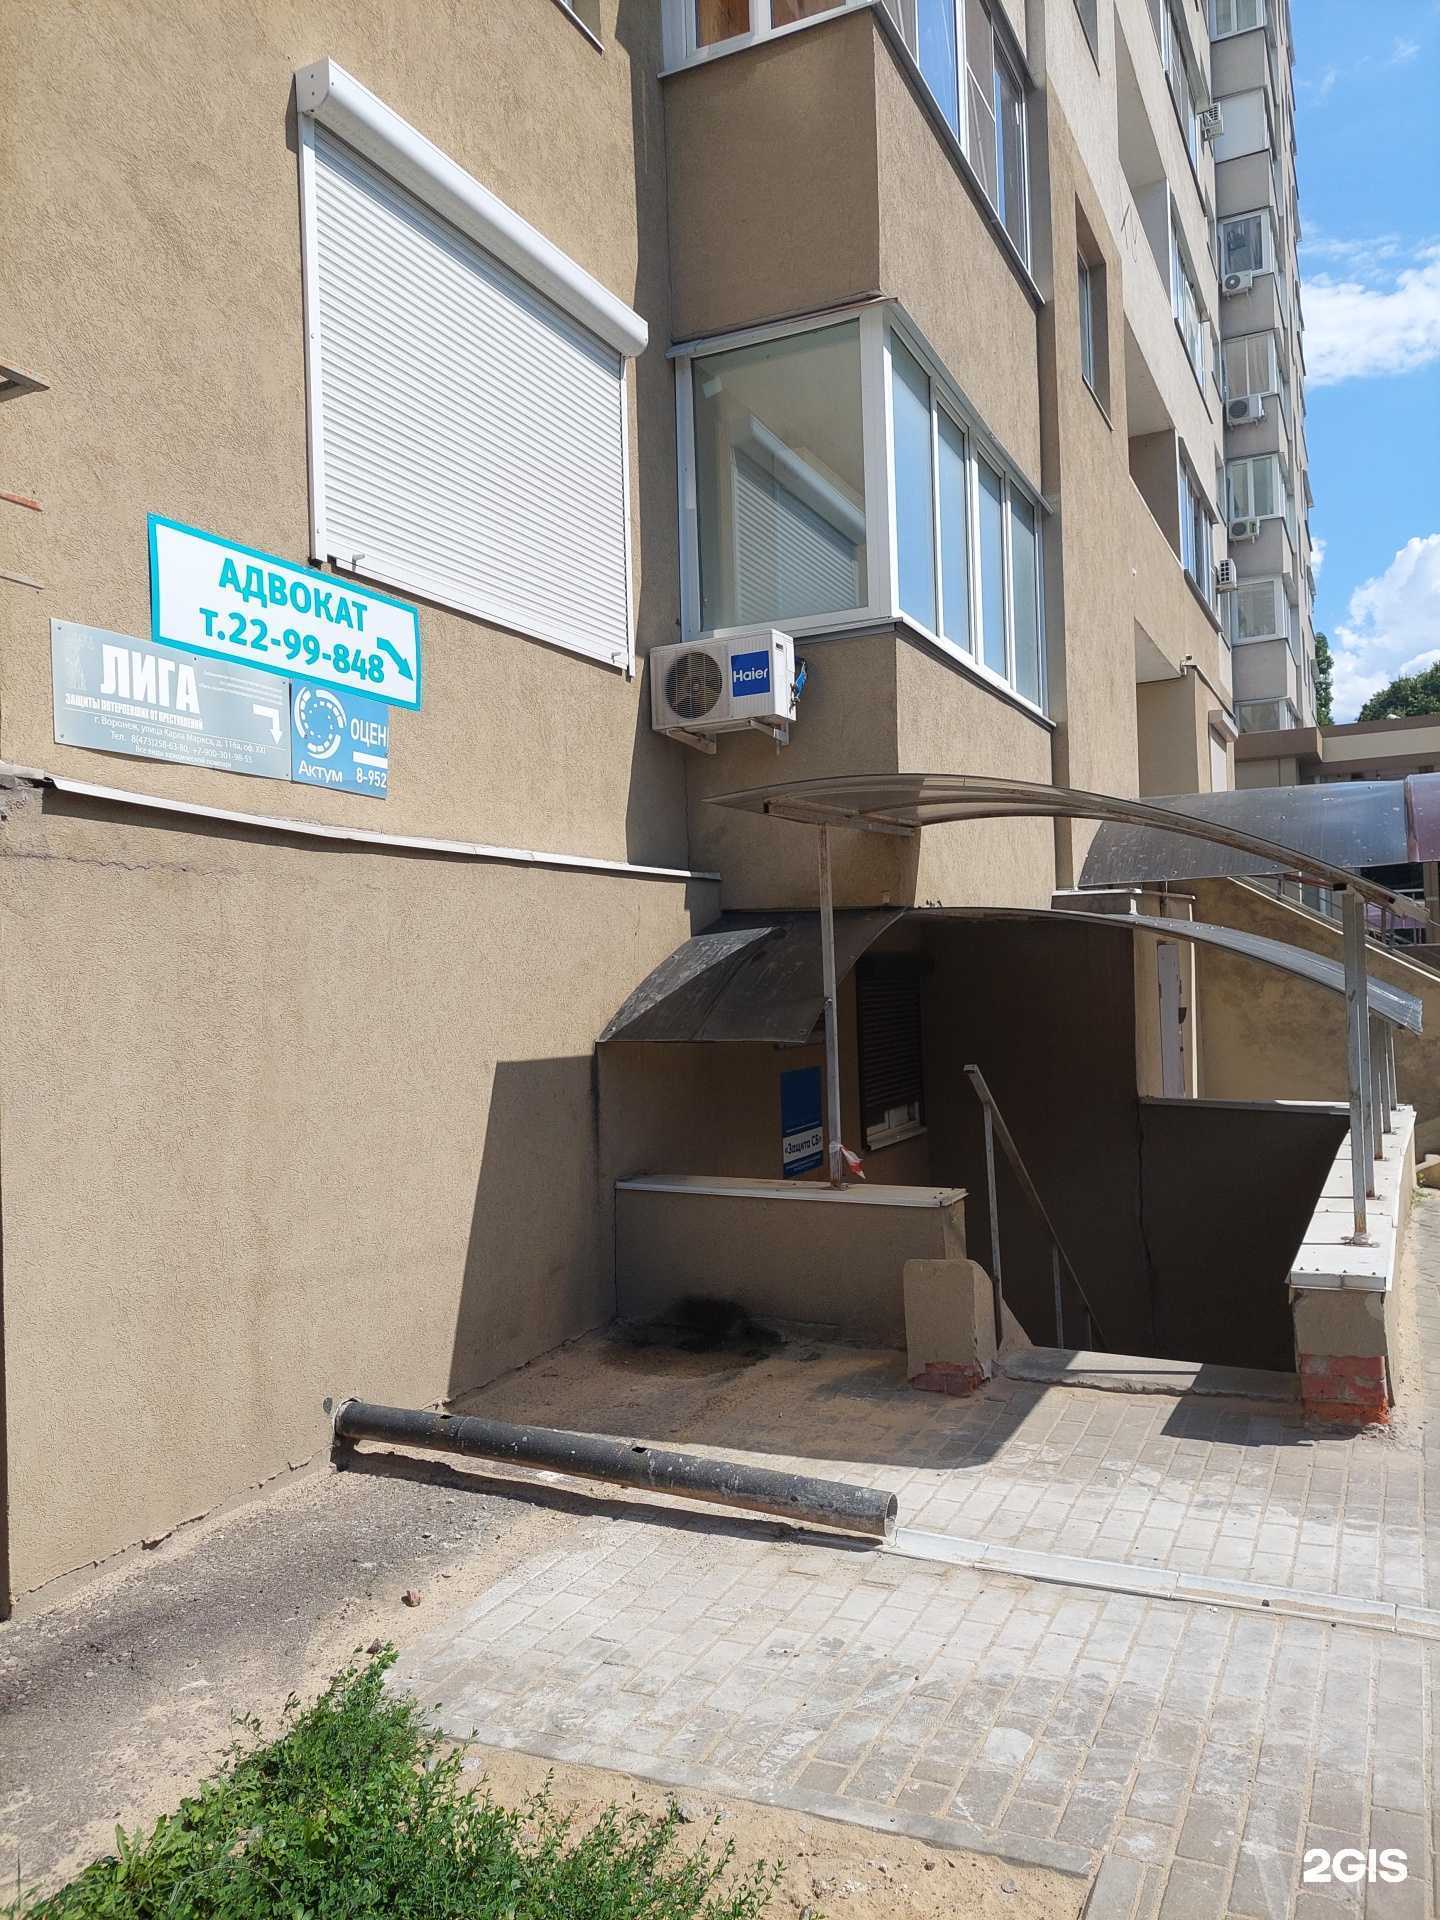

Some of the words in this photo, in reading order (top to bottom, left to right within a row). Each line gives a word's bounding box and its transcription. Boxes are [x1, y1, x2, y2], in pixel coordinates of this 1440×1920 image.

[219, 558, 368, 632] АДВОКАТ
[100, 643, 201, 714] ЛИГА
[733, 667, 768, 683] Haier
[65, 692, 100, 710] ЗАЩИТЫ
[150, 709, 159, 721] ОТ
[298, 759, 343, 784] Актум
